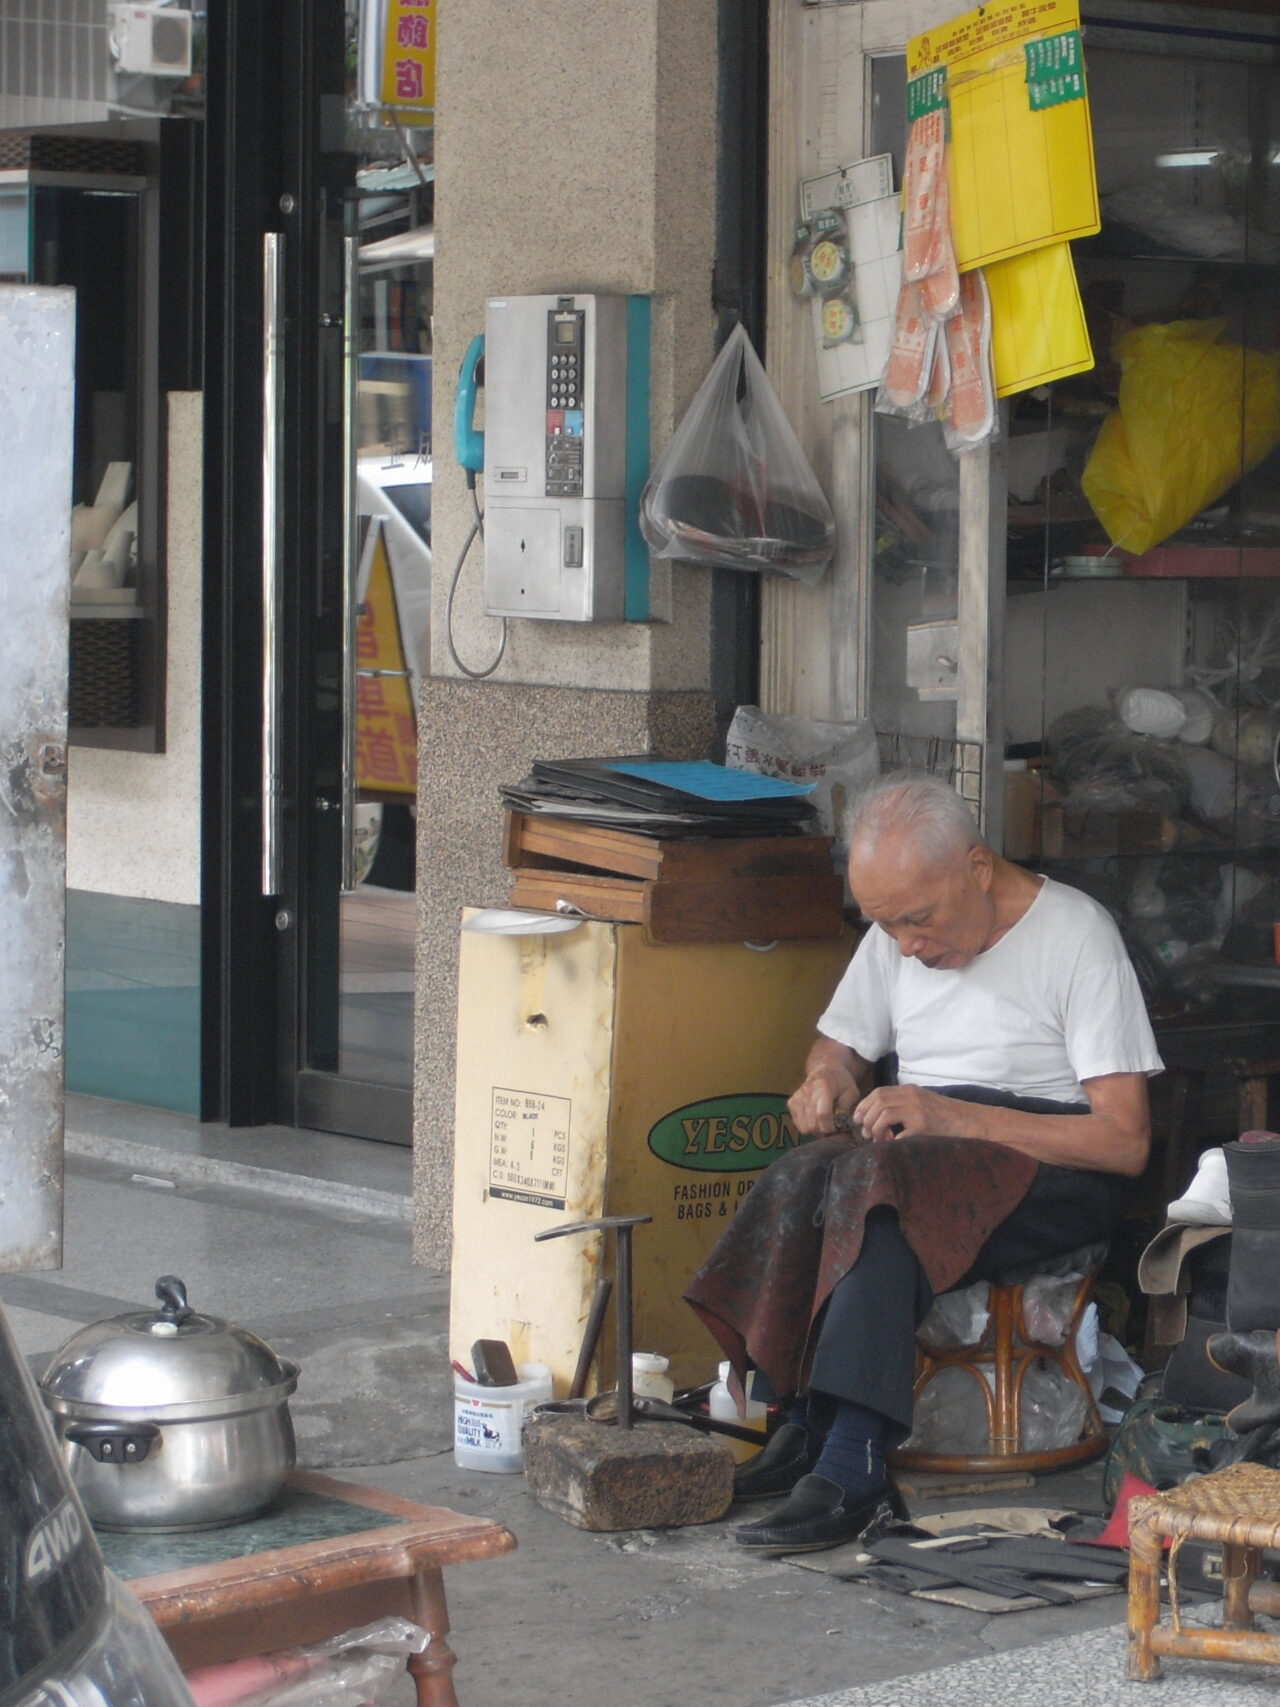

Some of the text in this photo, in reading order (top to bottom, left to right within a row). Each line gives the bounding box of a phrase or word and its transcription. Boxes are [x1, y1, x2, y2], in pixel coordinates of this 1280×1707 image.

[674, 1181, 731, 1200] FASHION
[677, 1202, 712, 1219] BAGS
[718, 1202, 727, 1216] &
[27, 1501, 82, 1579] 4WD
